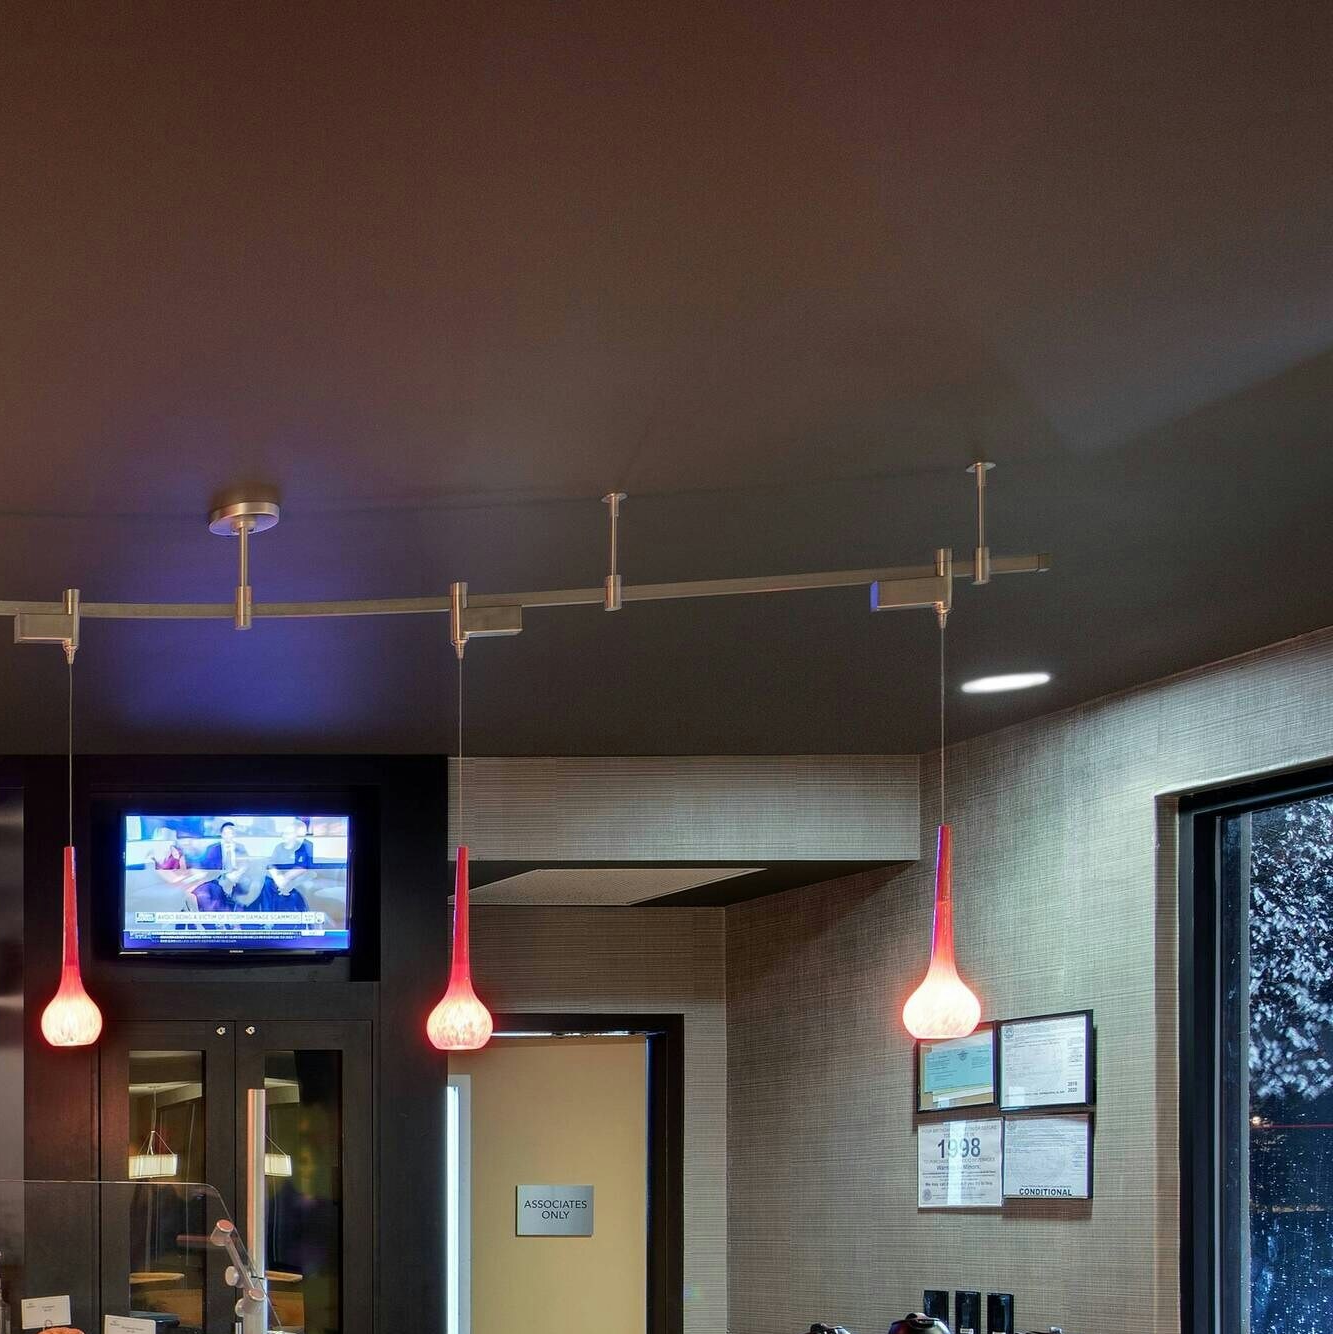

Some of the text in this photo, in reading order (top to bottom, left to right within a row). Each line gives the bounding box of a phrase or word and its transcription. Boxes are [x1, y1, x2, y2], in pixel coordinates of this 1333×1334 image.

[937, 1137, 981, 1159] 1998
[1019, 1188, 1073, 1197] CONDITIONAL
[524, 1200, 588, 1209] ASSOCIATES
[541, 1210, 570, 1220] ONLY
